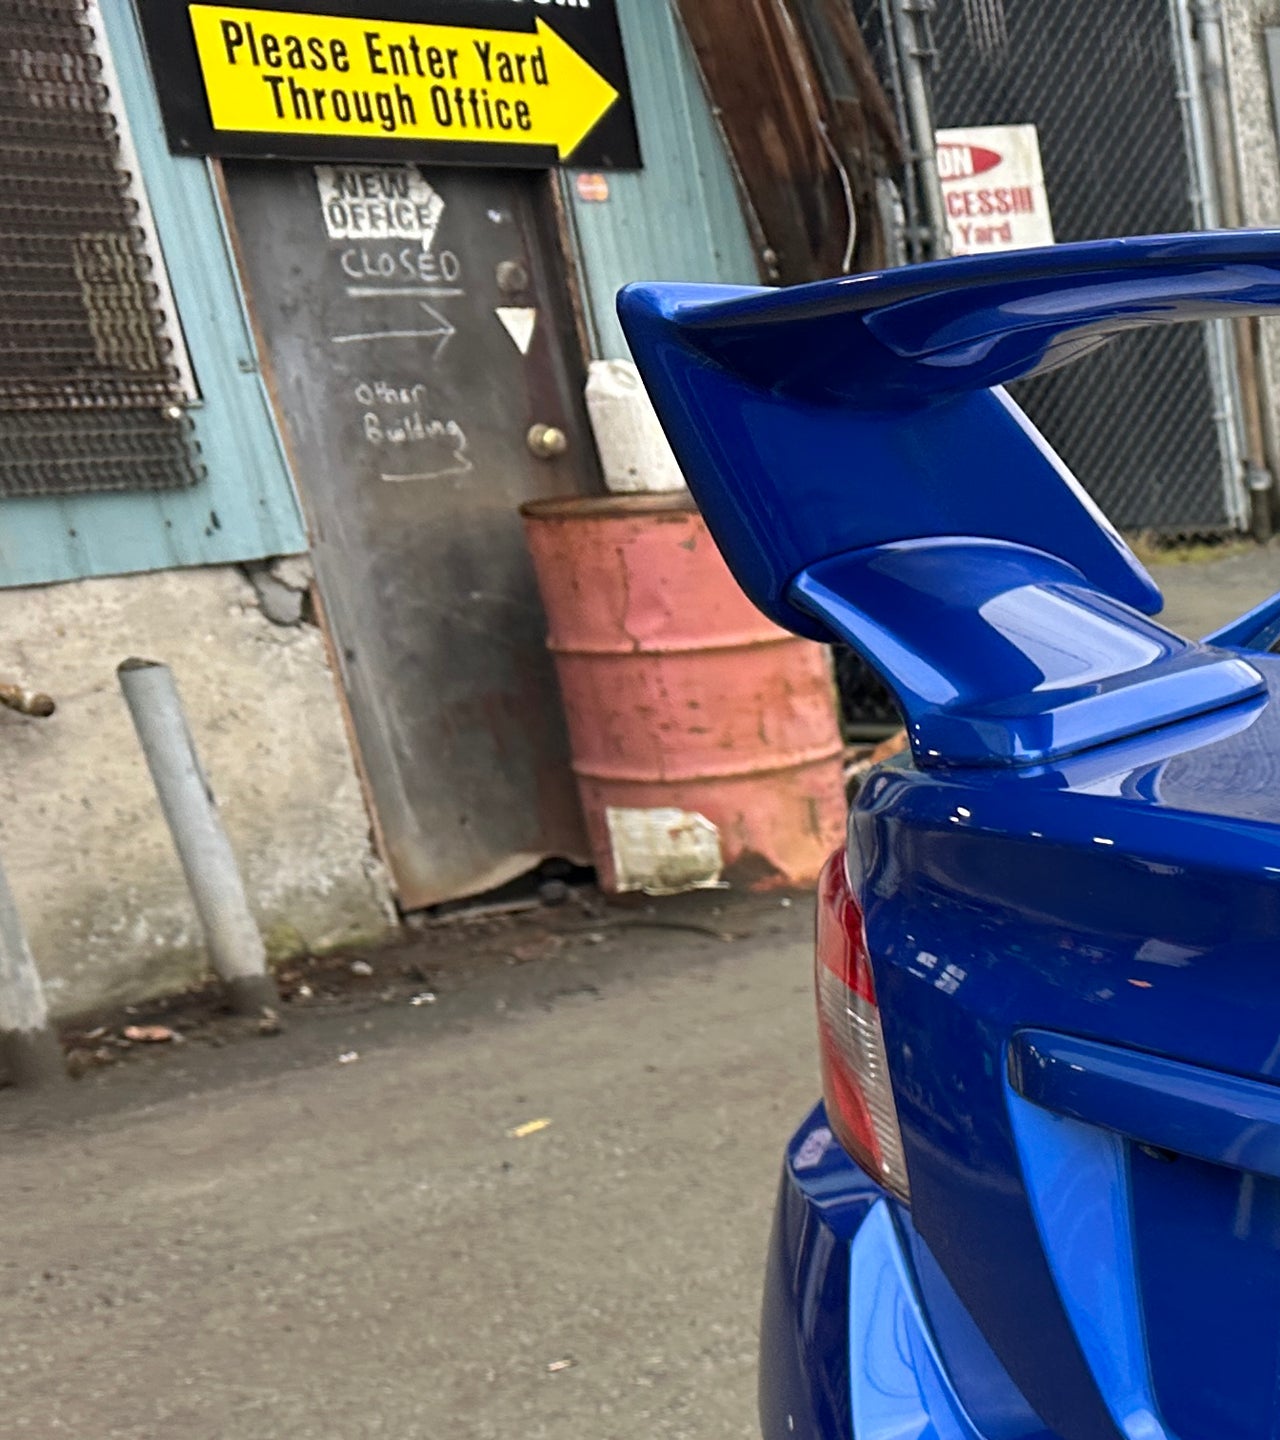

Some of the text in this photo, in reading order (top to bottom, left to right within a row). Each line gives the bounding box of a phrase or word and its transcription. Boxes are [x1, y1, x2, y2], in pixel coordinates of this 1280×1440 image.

[220, 19, 549, 87] Please Enter Yard
[262, 75, 532, 133] Through Office
[336, 171, 410, 199] NEW
[328, 200, 434, 230] OFFICE
[341, 248, 460, 282] CLOSED
